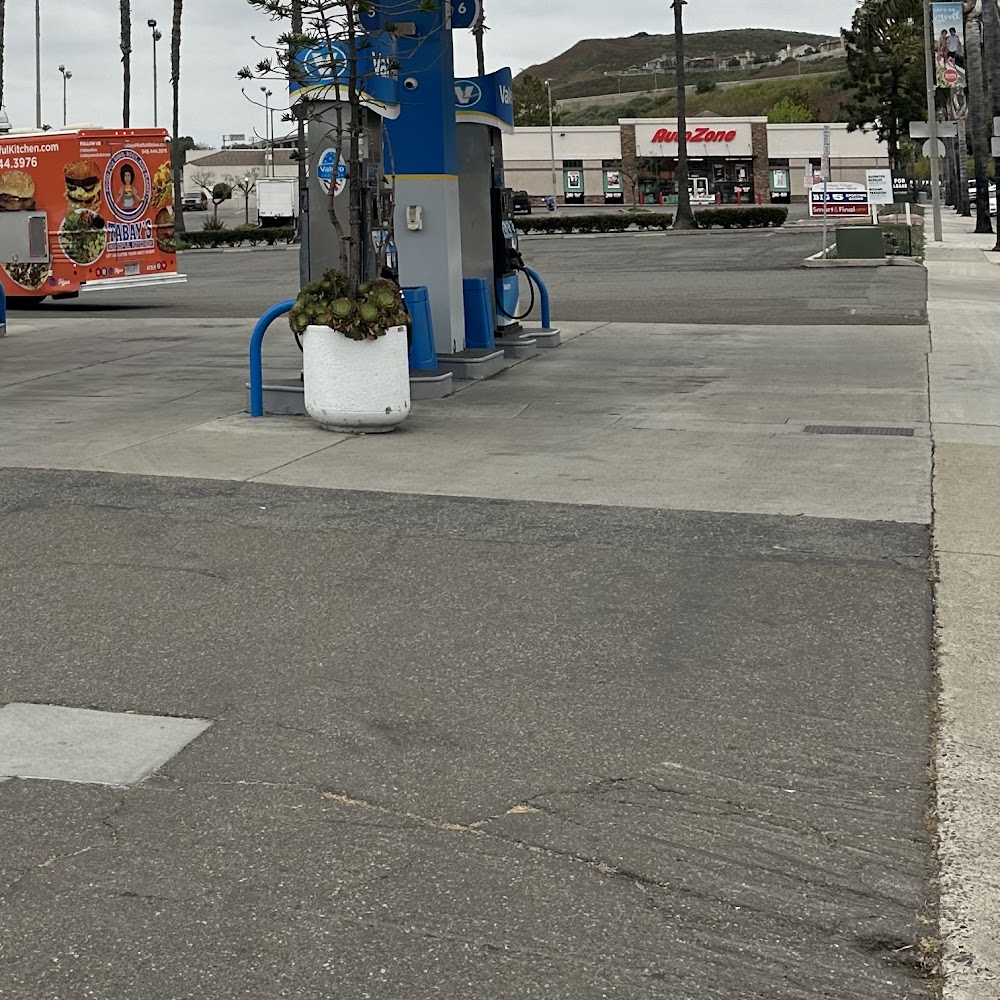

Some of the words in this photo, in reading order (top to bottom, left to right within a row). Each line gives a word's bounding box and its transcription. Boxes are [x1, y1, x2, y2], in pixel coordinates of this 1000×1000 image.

[457, 2, 467, 14] 6
[651, 127, 737, 143] AuoZone
[832, 193, 845, 201] 5
[107, 218, 153, 242] TABAY'S
